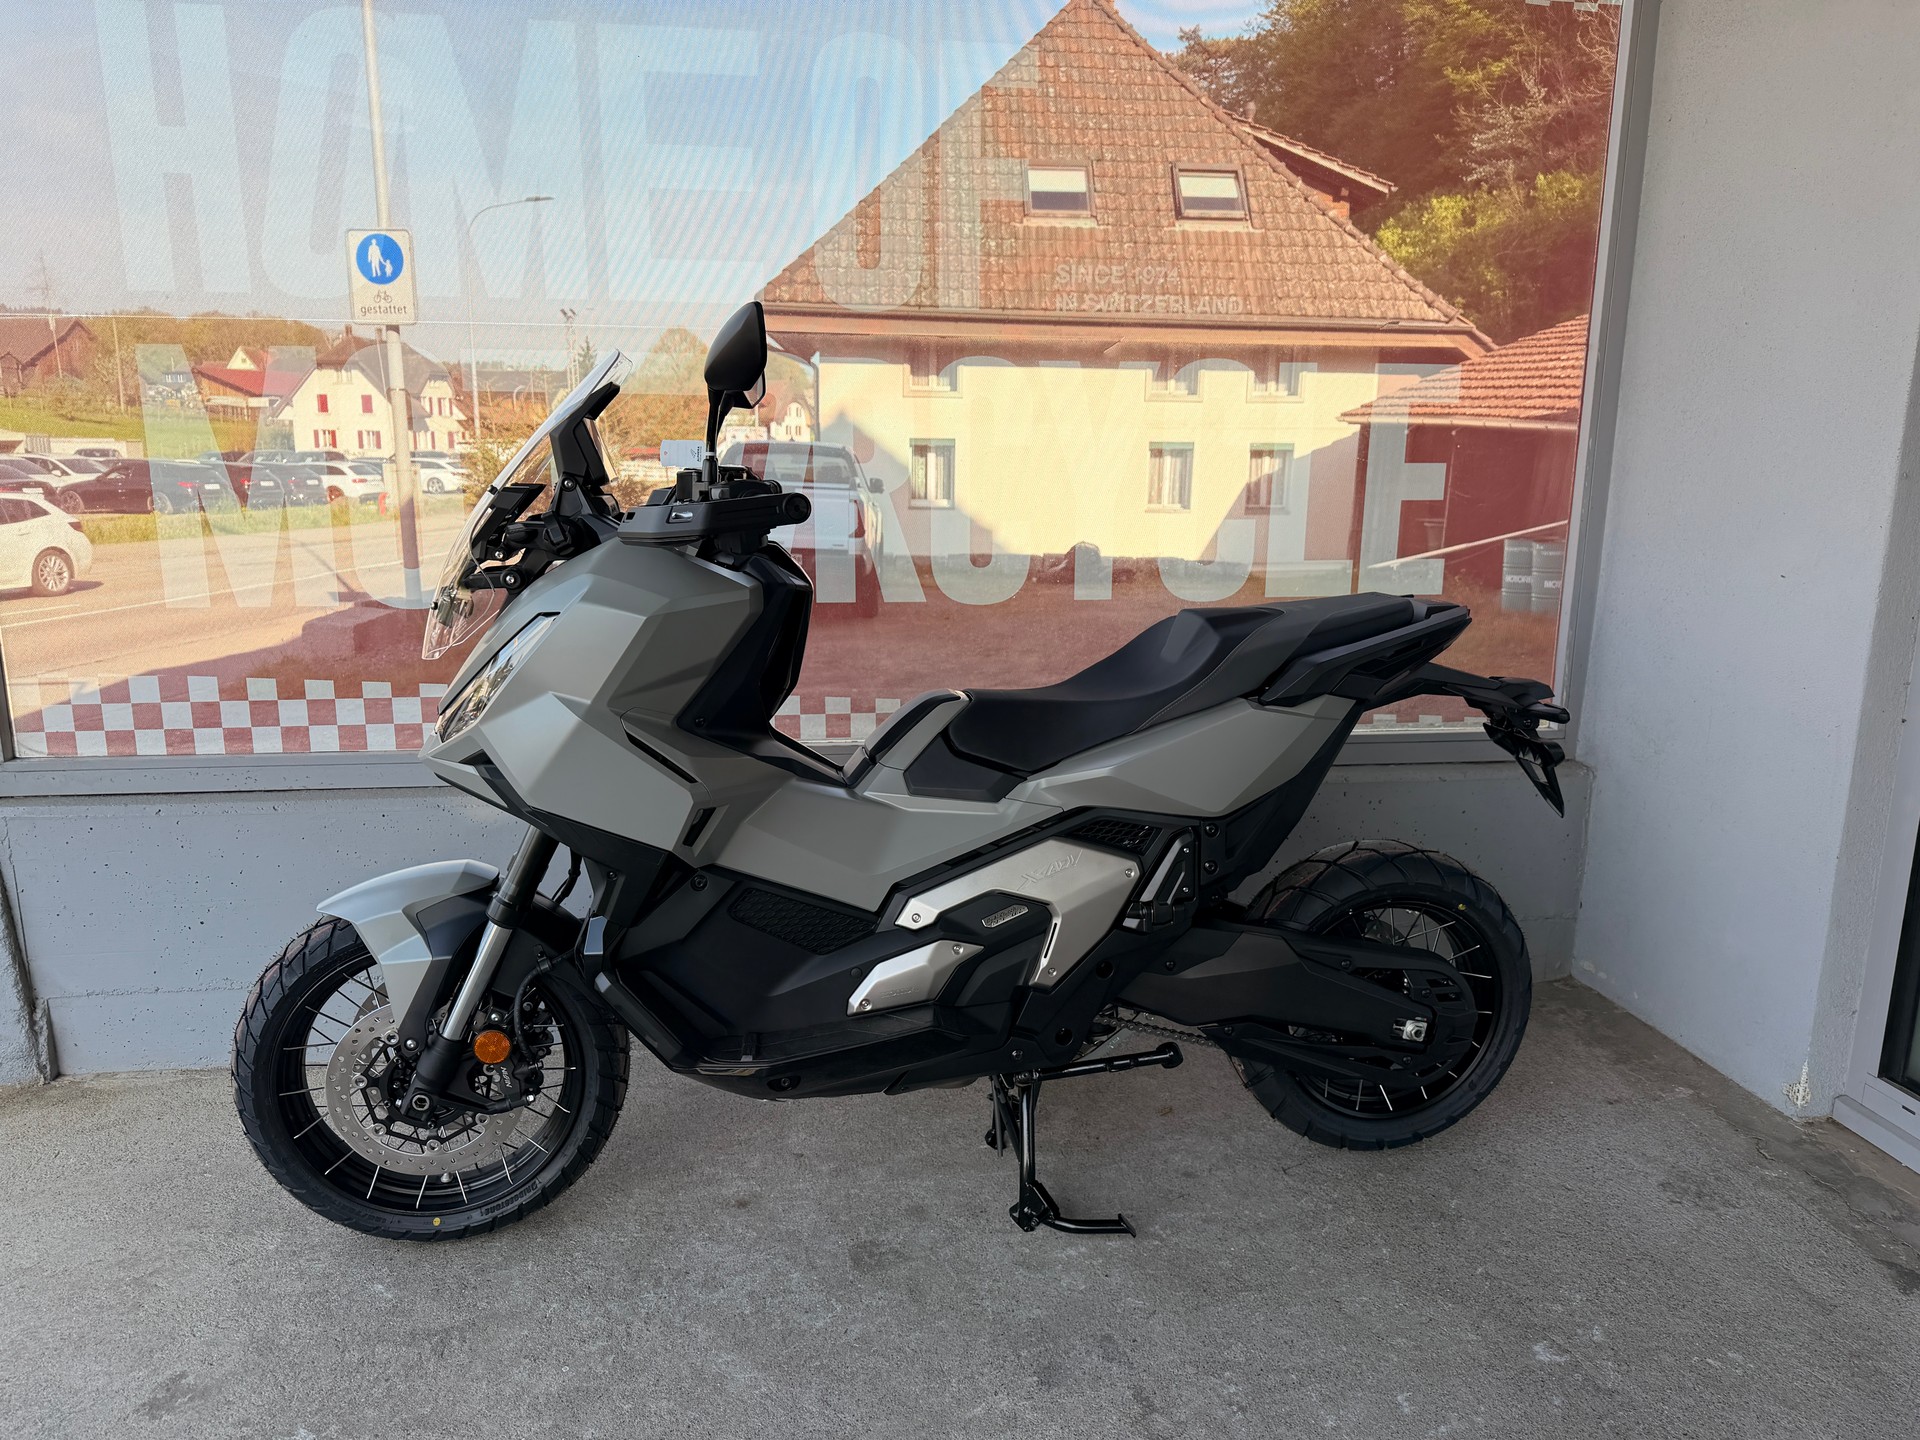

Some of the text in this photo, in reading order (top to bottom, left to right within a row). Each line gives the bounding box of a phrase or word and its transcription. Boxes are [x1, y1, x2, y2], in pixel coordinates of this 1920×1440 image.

[95, 0, 1041, 313] HOME OF
[1055, 263, 1181, 285] SINCE 1974
[360, 305, 407, 316] gestattet
[1083, 293, 1244, 314] SWITZERLAND
[484, 1182, 538, 1216] BRIDGESTONE
